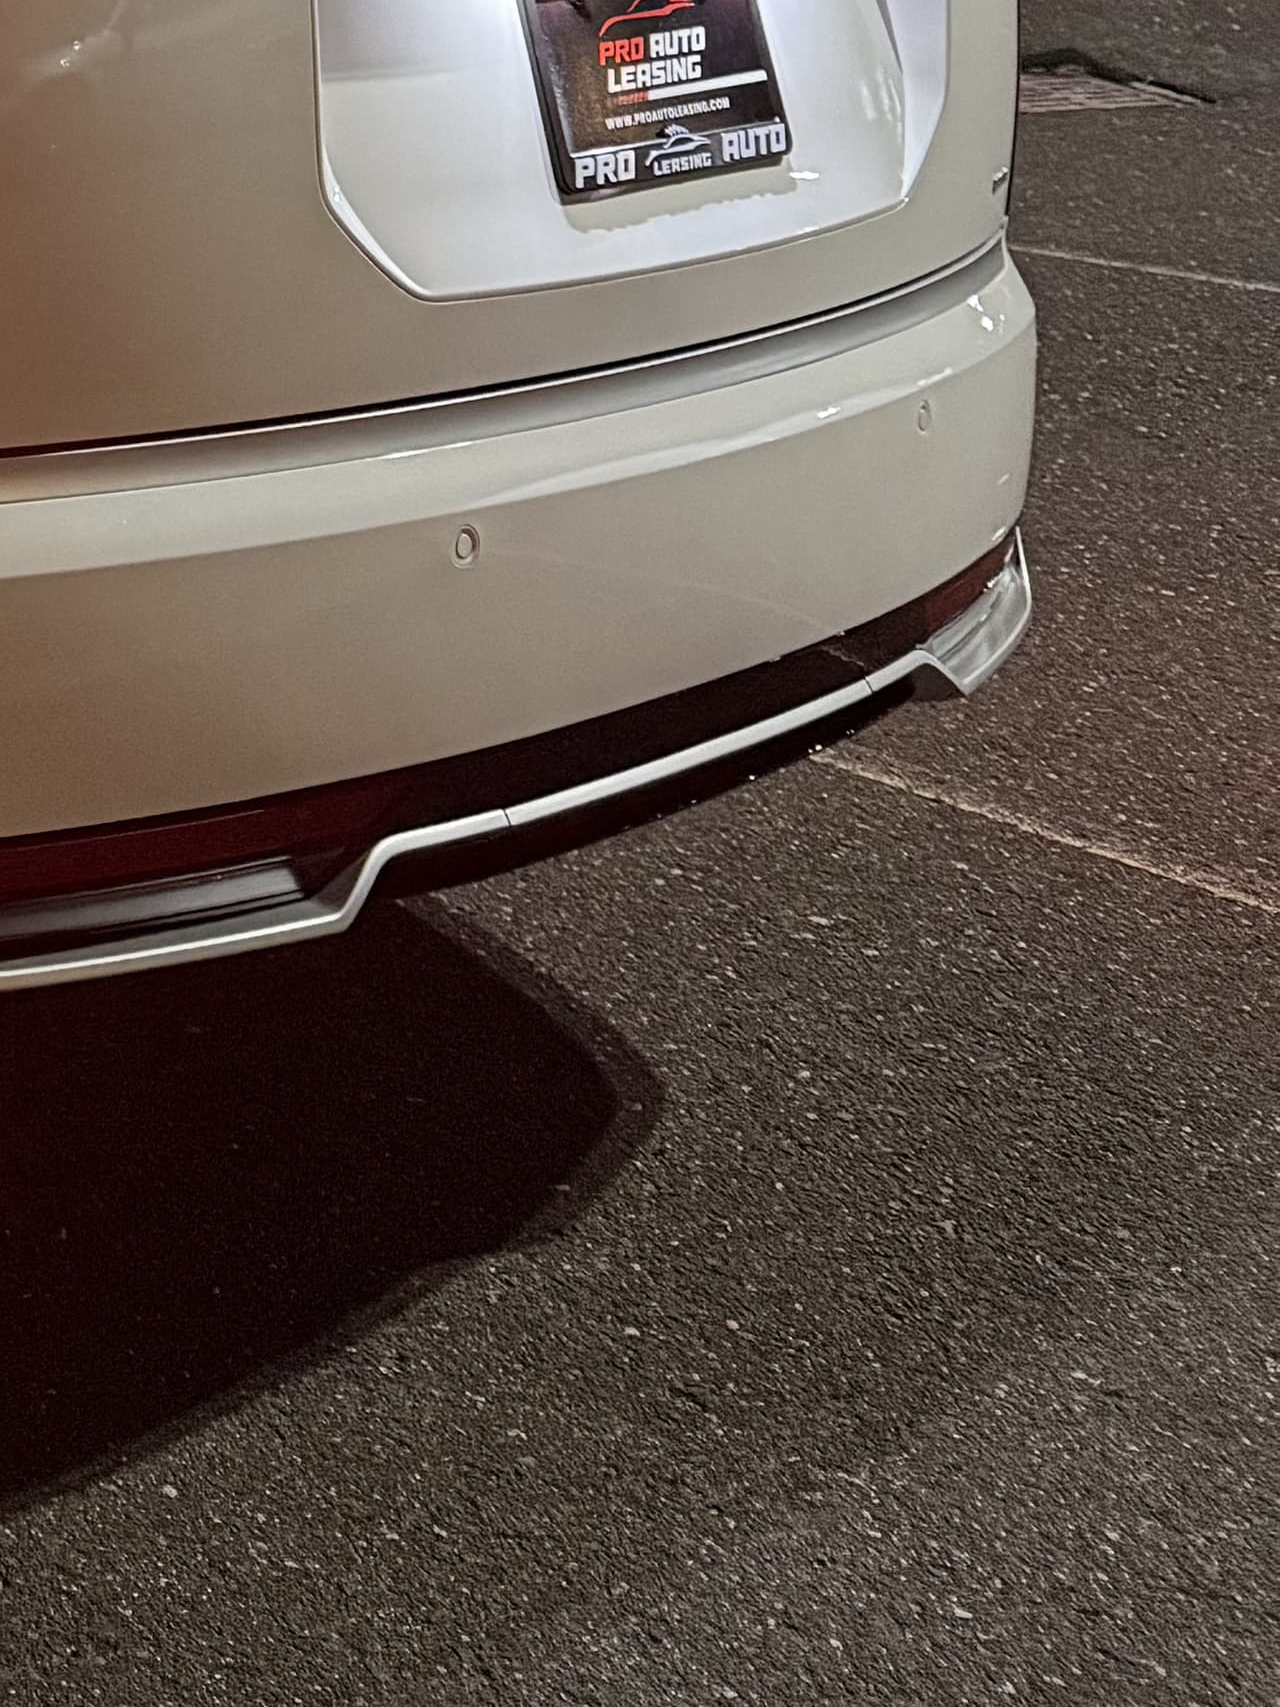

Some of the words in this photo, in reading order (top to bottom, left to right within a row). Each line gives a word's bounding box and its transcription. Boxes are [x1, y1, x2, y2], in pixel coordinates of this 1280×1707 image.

[598, 36, 644, 66] PRO
[649, 26, 706, 58] AUTO
[607, 54, 702, 92] LEASING
[605, 97, 730, 130] WWW.PROAUTOLEASING.COM
[575, 150, 636, 188] PRO
[653, 152, 712, 176] LEASING
[721, 123, 786, 162] AUTO
